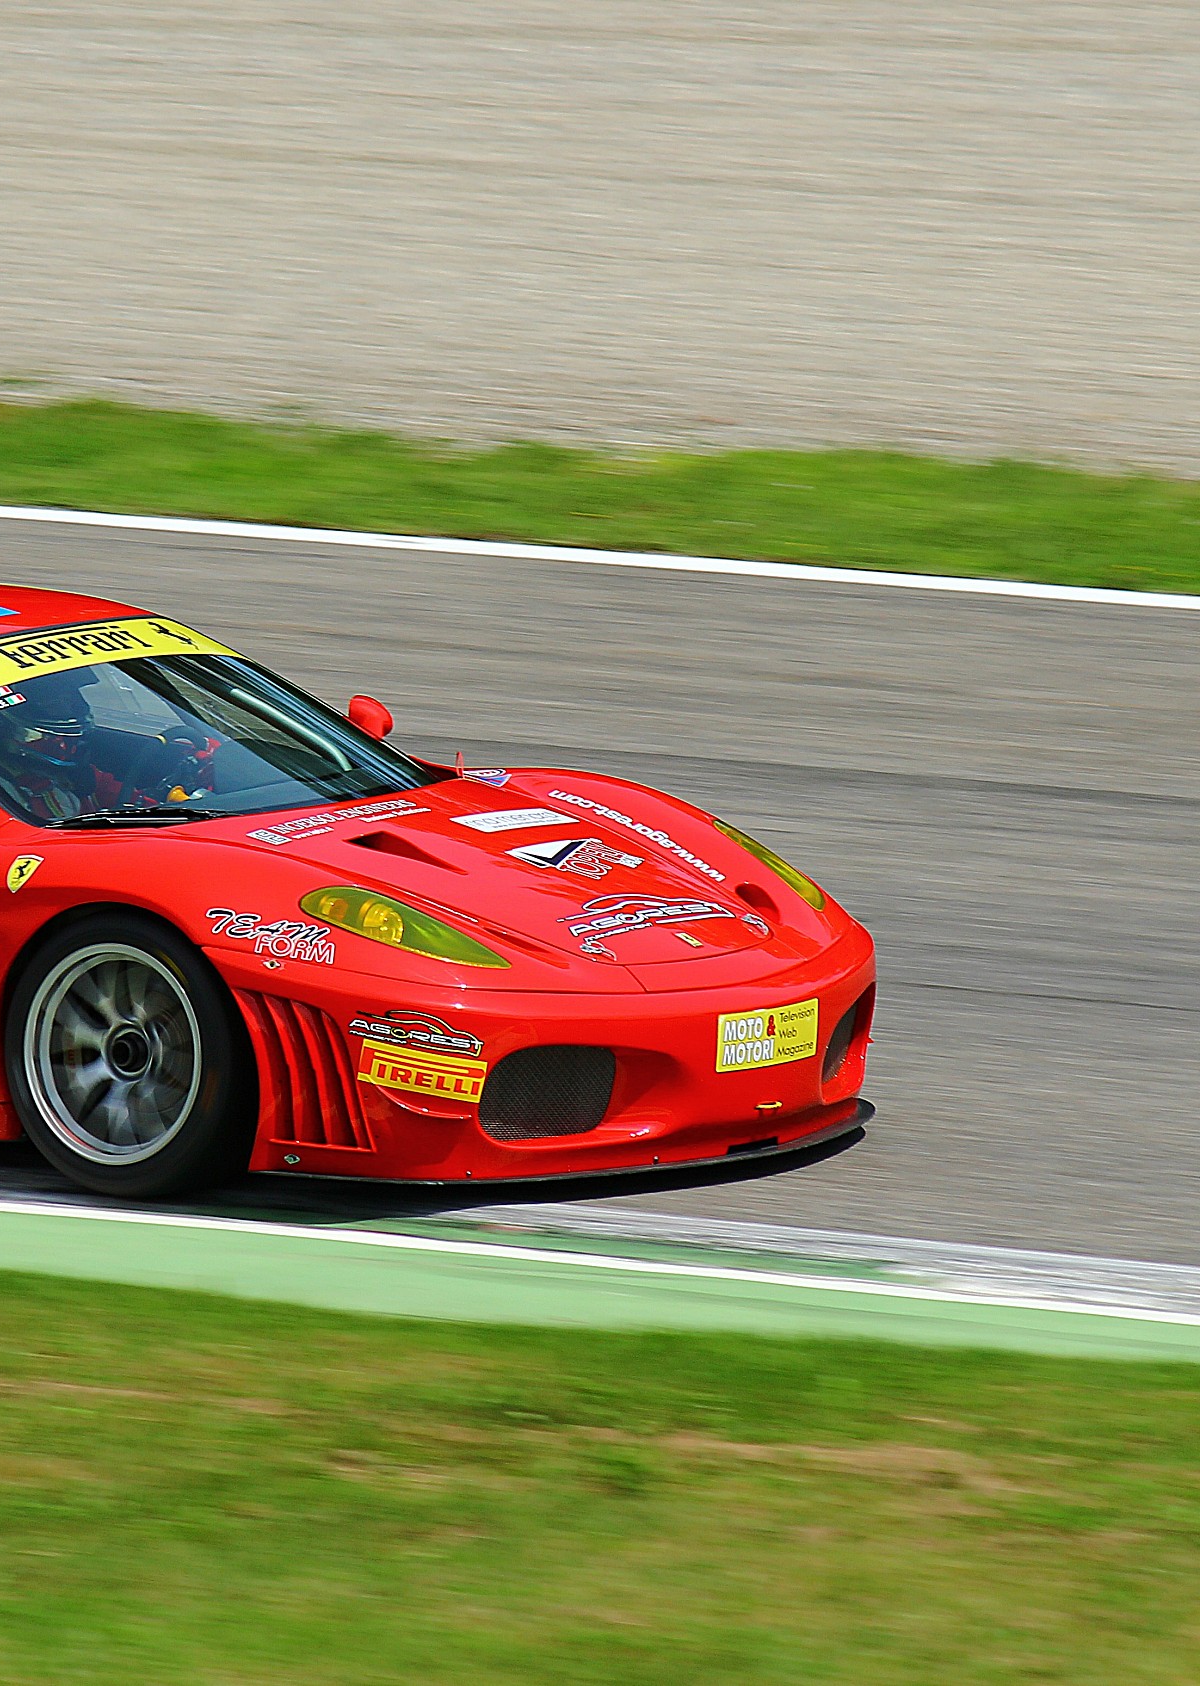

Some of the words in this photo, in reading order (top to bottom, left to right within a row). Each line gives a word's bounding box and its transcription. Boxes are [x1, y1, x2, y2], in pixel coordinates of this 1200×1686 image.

[268, 812, 346, 835] INGERSOL
[334, 799, 418, 820] ENGINEERS
[548, 789, 727, 883] www.agorest.com
[205, 907, 331, 947] TEAM
[253, 933, 336, 965] FORM
[723, 1016, 764, 1043] MOTO
[766, 1014, 776, 1037] &
[779, 1007, 816, 1023] Television
[349, 1019, 484, 1051] AGOREST
[776, 1040, 814, 1058] Magazine
[779, 1028, 798, 1039] Web
[721, 1037, 776, 1067] MOTORI
[359, 1045, 486, 1097] PIRELLI
